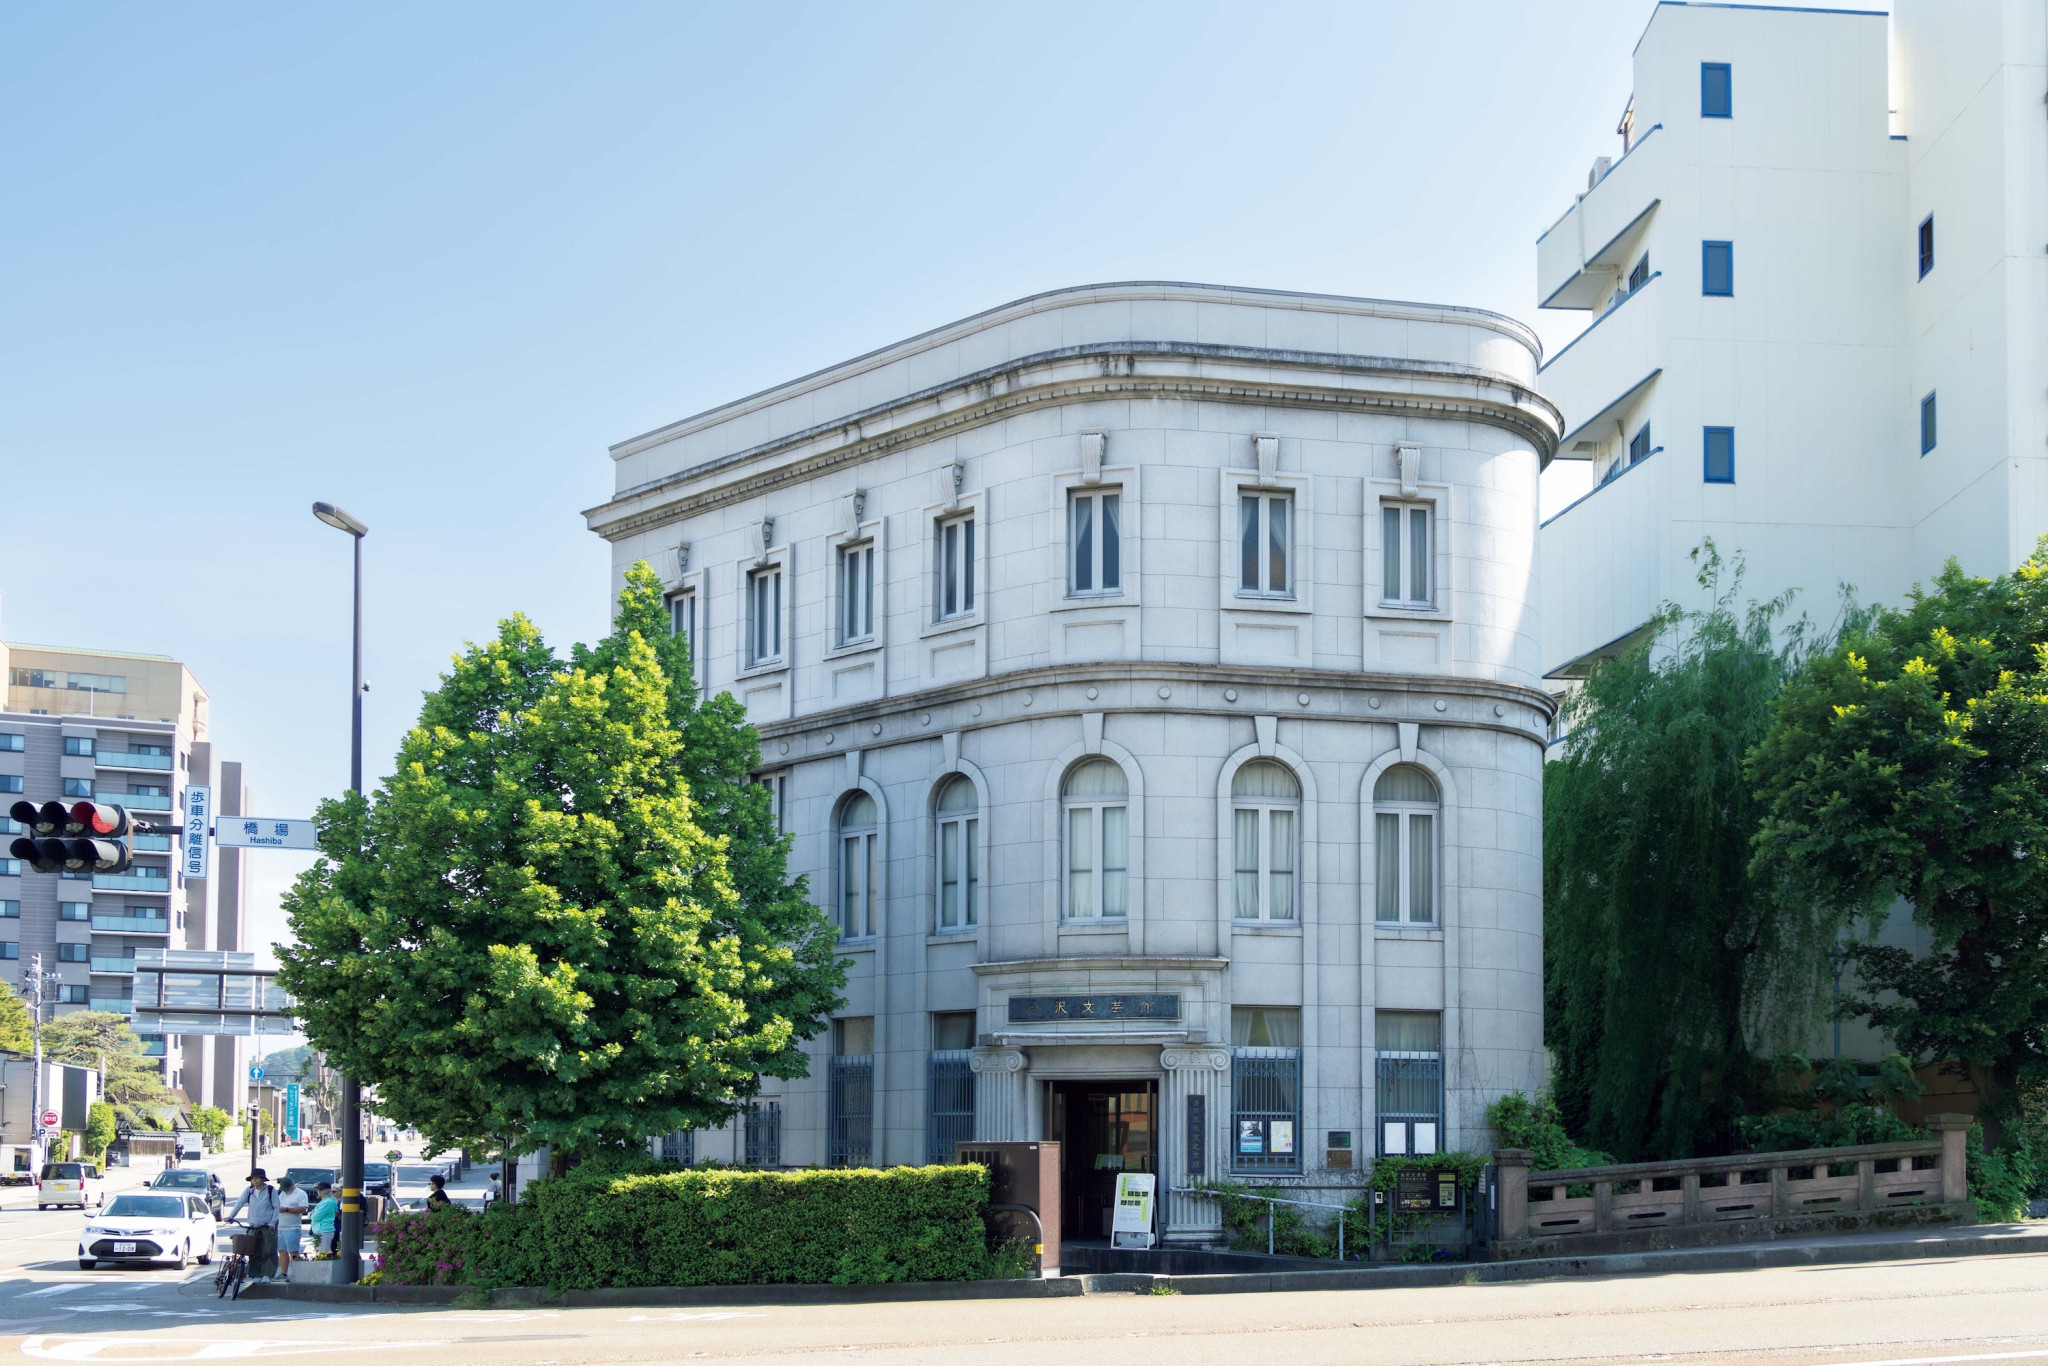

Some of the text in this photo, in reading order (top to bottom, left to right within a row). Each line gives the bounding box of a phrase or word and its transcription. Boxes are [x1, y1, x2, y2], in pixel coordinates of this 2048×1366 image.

[188, 791, 205, 873] 歩車分離信号
[243, 821, 289, 837] 橋場
[250, 836, 283, 845] Hashiba
[1029, 1000, 1154, 1015] 金沢文芸館
[39, 1128, 46, 1137] P
